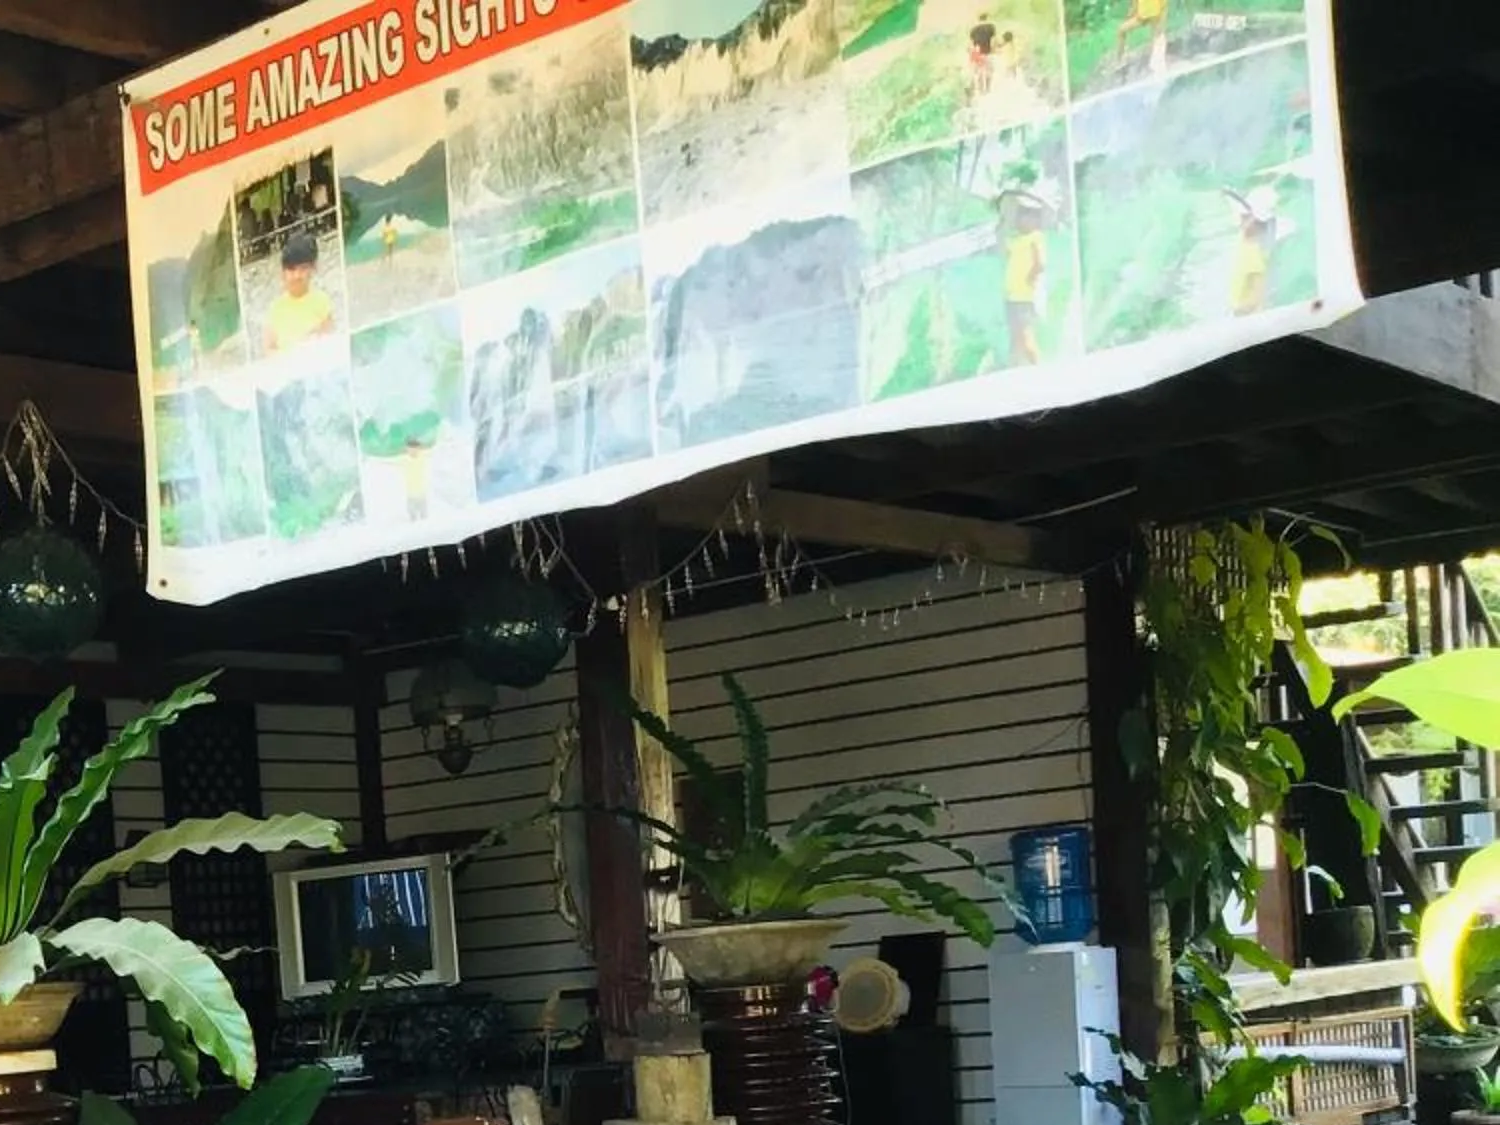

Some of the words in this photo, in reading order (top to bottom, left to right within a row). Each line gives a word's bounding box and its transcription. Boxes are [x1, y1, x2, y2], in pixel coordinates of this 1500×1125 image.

[145, 79, 237, 171] SOME
[246, 10, 404, 133] AMAZING
[414, 0, 556, 63] SIGH
